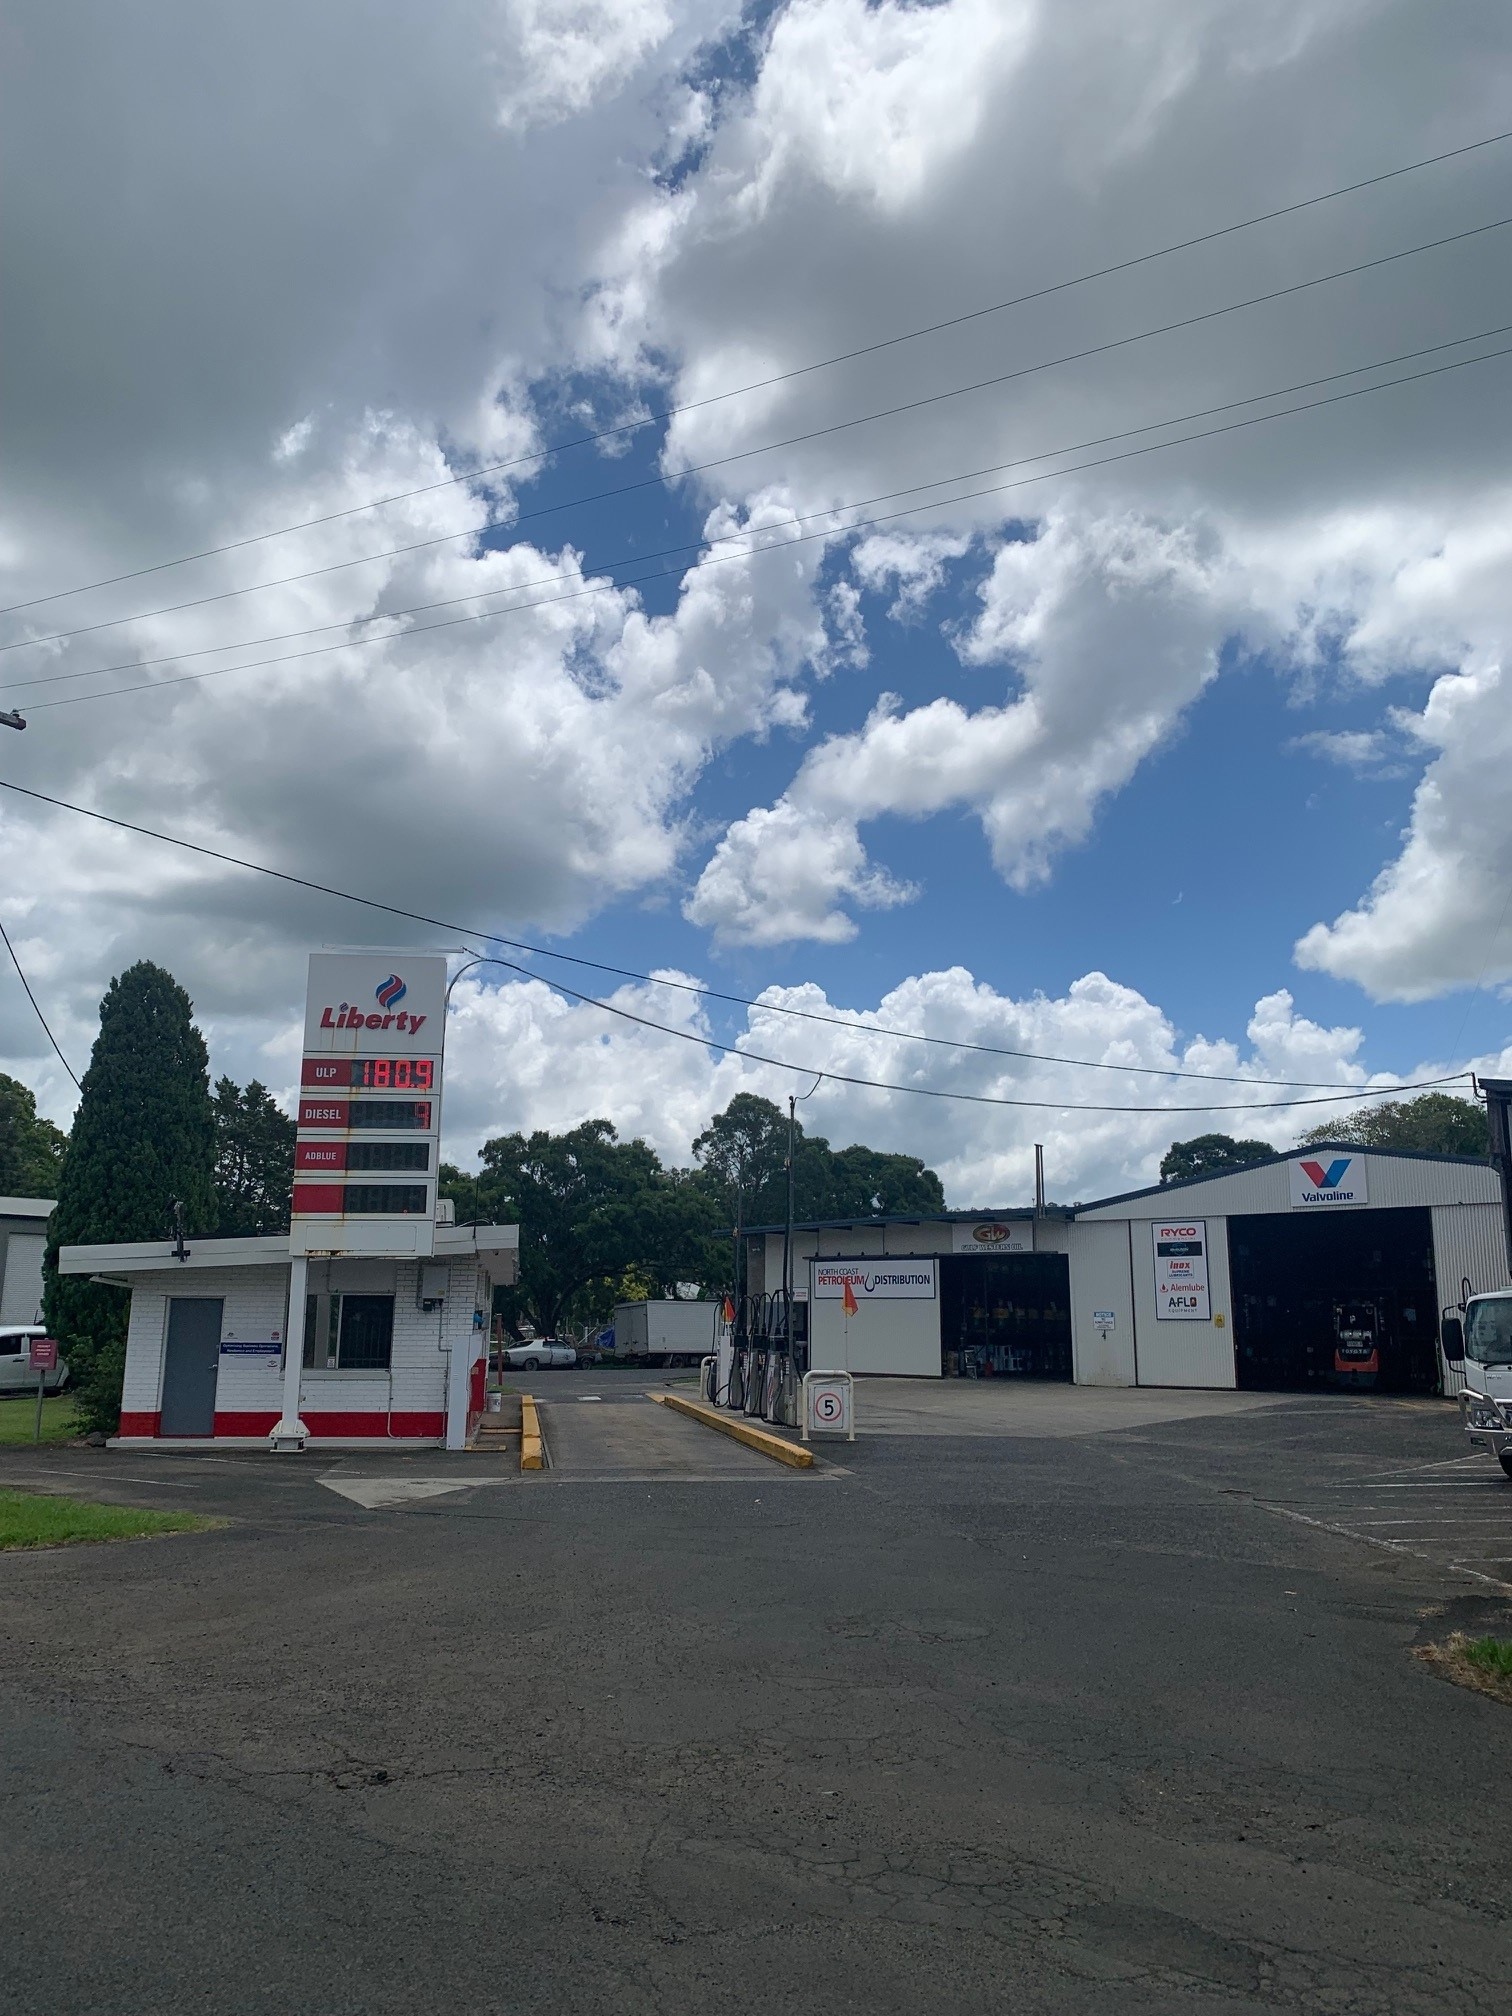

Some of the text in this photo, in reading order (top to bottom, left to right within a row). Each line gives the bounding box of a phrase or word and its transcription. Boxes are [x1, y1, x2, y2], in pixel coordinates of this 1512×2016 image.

[320, 1003, 427, 1035] Liberty
[315, 1067, 337, 1078] ULP
[305, 1108, 342, 1120] DIESEL
[304, 1151, 337, 1161] ADBLUE
[1301, 1191, 1354, 1203] Valvoline
[1160, 1227, 1197, 1237] RYCO
[818, 1267, 859, 1276] NORTH COAST
[874, 1274, 931, 1286] DISTRIBUTION
[1170, 1282, 1205, 1292] Alemlube
[824, 1399, 834, 1416] 5
